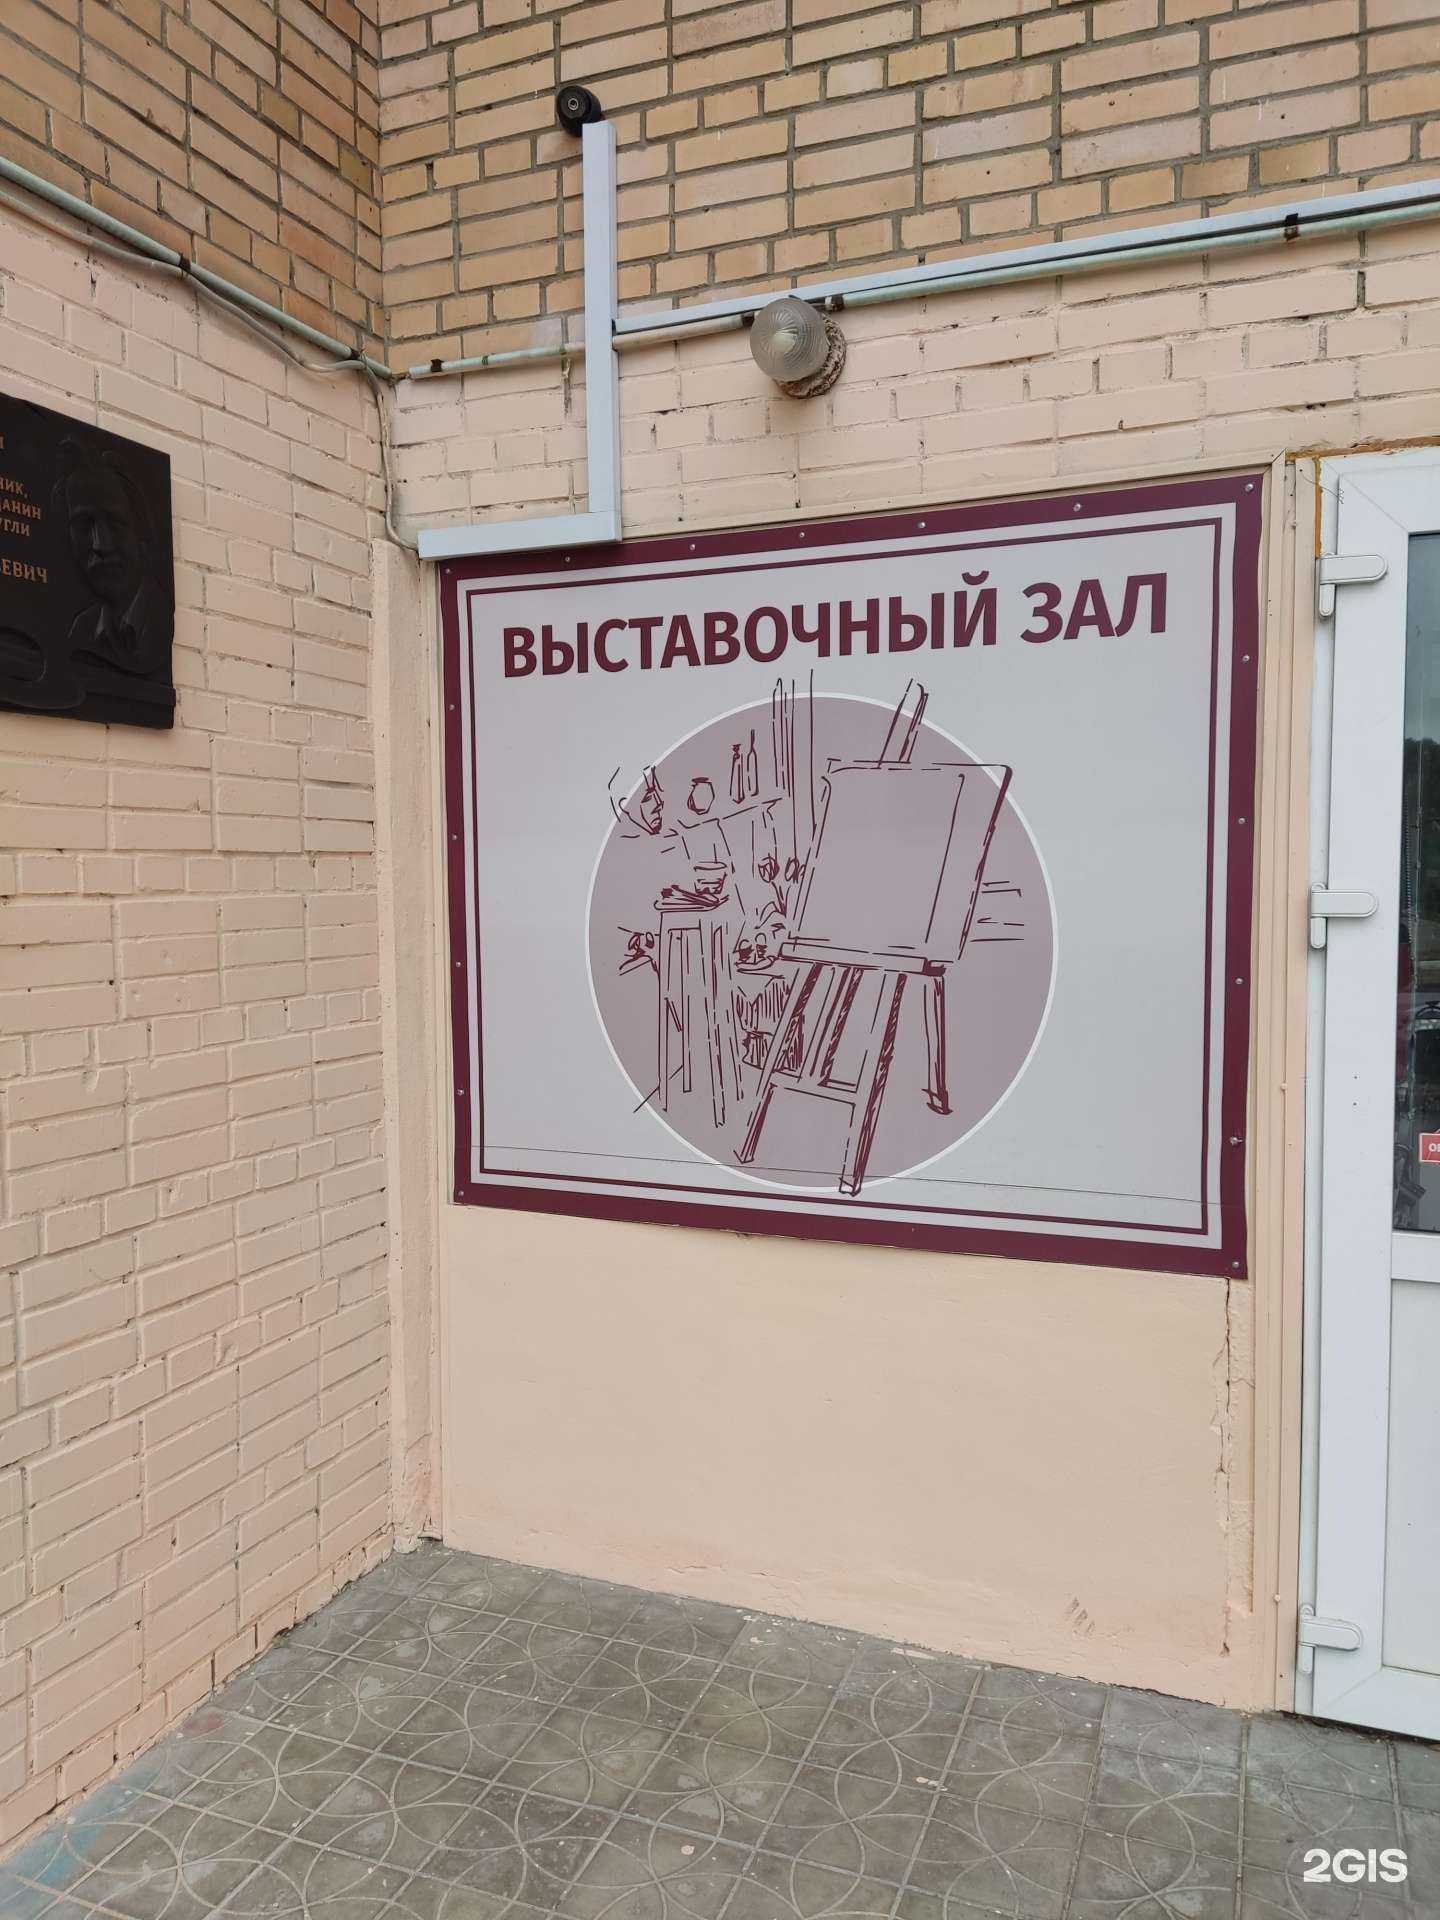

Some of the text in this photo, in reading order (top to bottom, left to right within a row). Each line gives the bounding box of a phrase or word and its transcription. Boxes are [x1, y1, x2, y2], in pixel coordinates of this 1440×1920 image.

[0, 498, 41, 520] АНИН
[0, 558, 48, 584] ЕВИЧ
[503, 570, 1168, 679] ВЫСТАВОЧНЫЙ ЗАЛ
